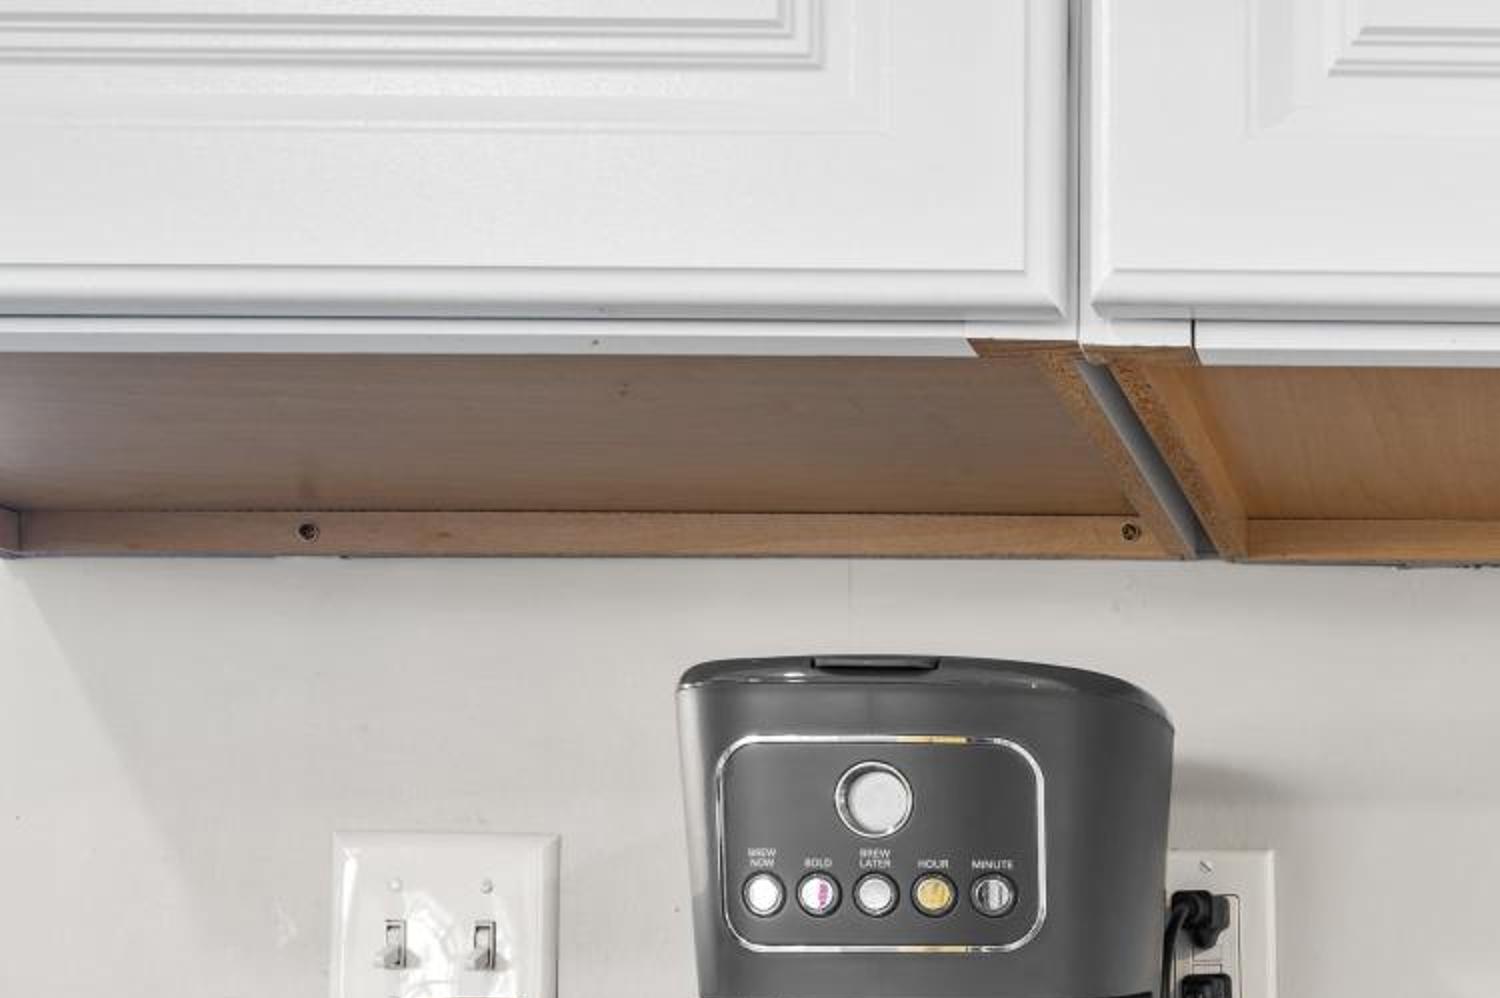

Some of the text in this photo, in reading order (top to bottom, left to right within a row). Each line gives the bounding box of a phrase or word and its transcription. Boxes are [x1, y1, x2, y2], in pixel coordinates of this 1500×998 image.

[747, 847, 777, 857] BREW
[859, 847, 891, 858] BREW
[749, 858, 775, 868] NOW
[803, 857, 832, 868] BOLD
[859, 858, 891, 868] LATER
[917, 859, 949, 869] HOUR
[971, 859, 1013, 869] MINUTE
